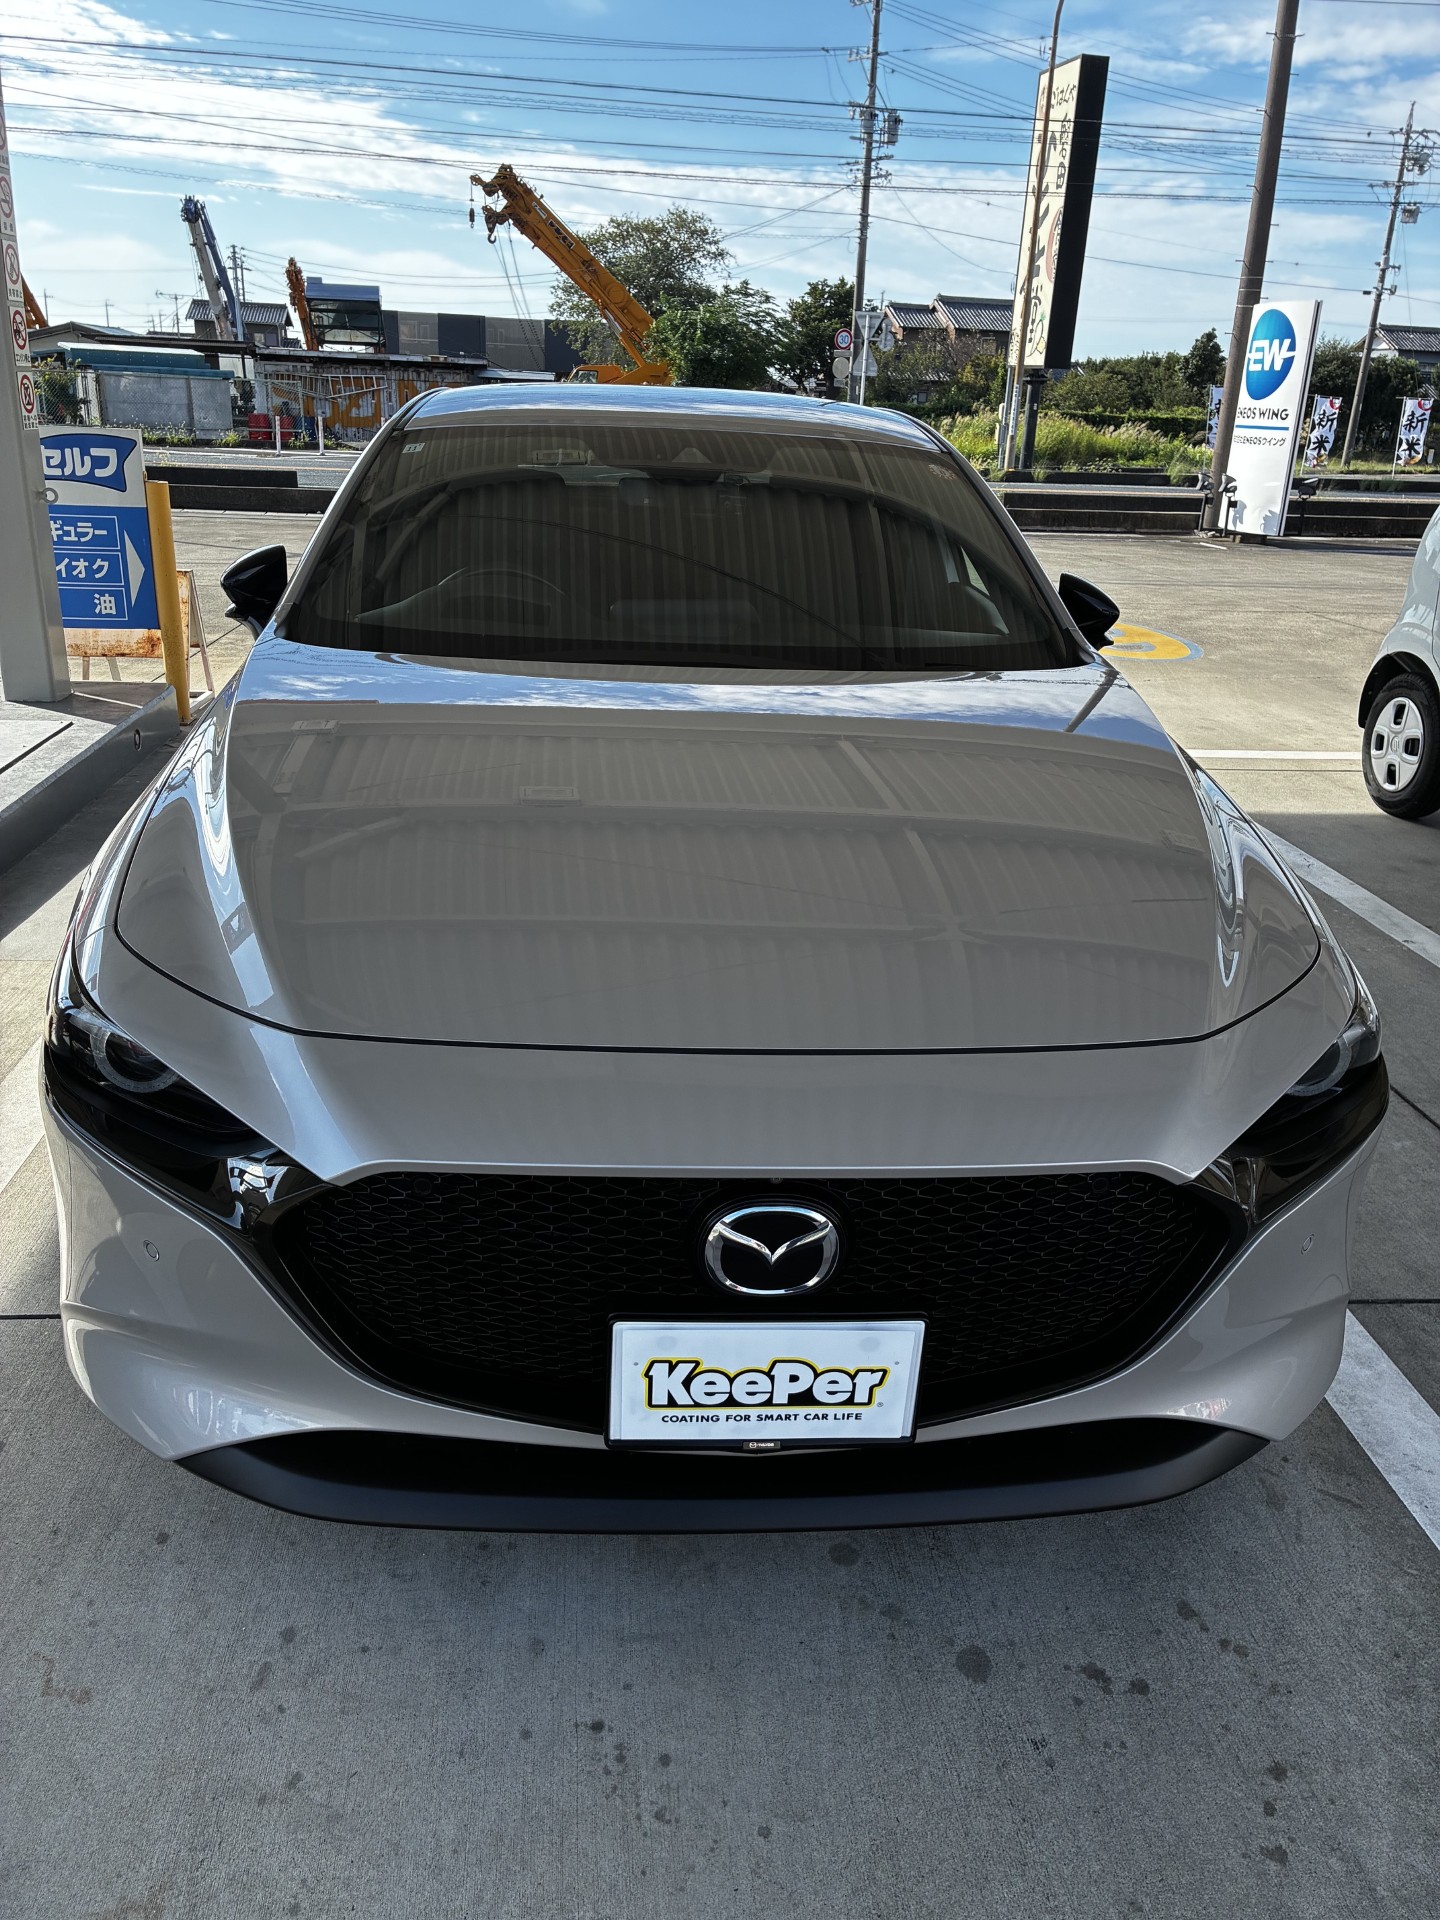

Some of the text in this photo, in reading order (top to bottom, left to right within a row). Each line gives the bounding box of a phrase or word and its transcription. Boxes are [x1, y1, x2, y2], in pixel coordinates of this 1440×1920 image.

[839, 335, 849, 345] 30
[1248, 338, 1295, 372] EW
[1258, 407, 1289, 421] WING
[1312, 409, 1338, 459] 新米
[1401, 410, 1428, 458] 新米
[41, 447, 118, 478] セルフ
[646, 1360, 886, 1408] KeePer
[661, 1412, 863, 1424] COATING FOR SMART CAR LIFE
